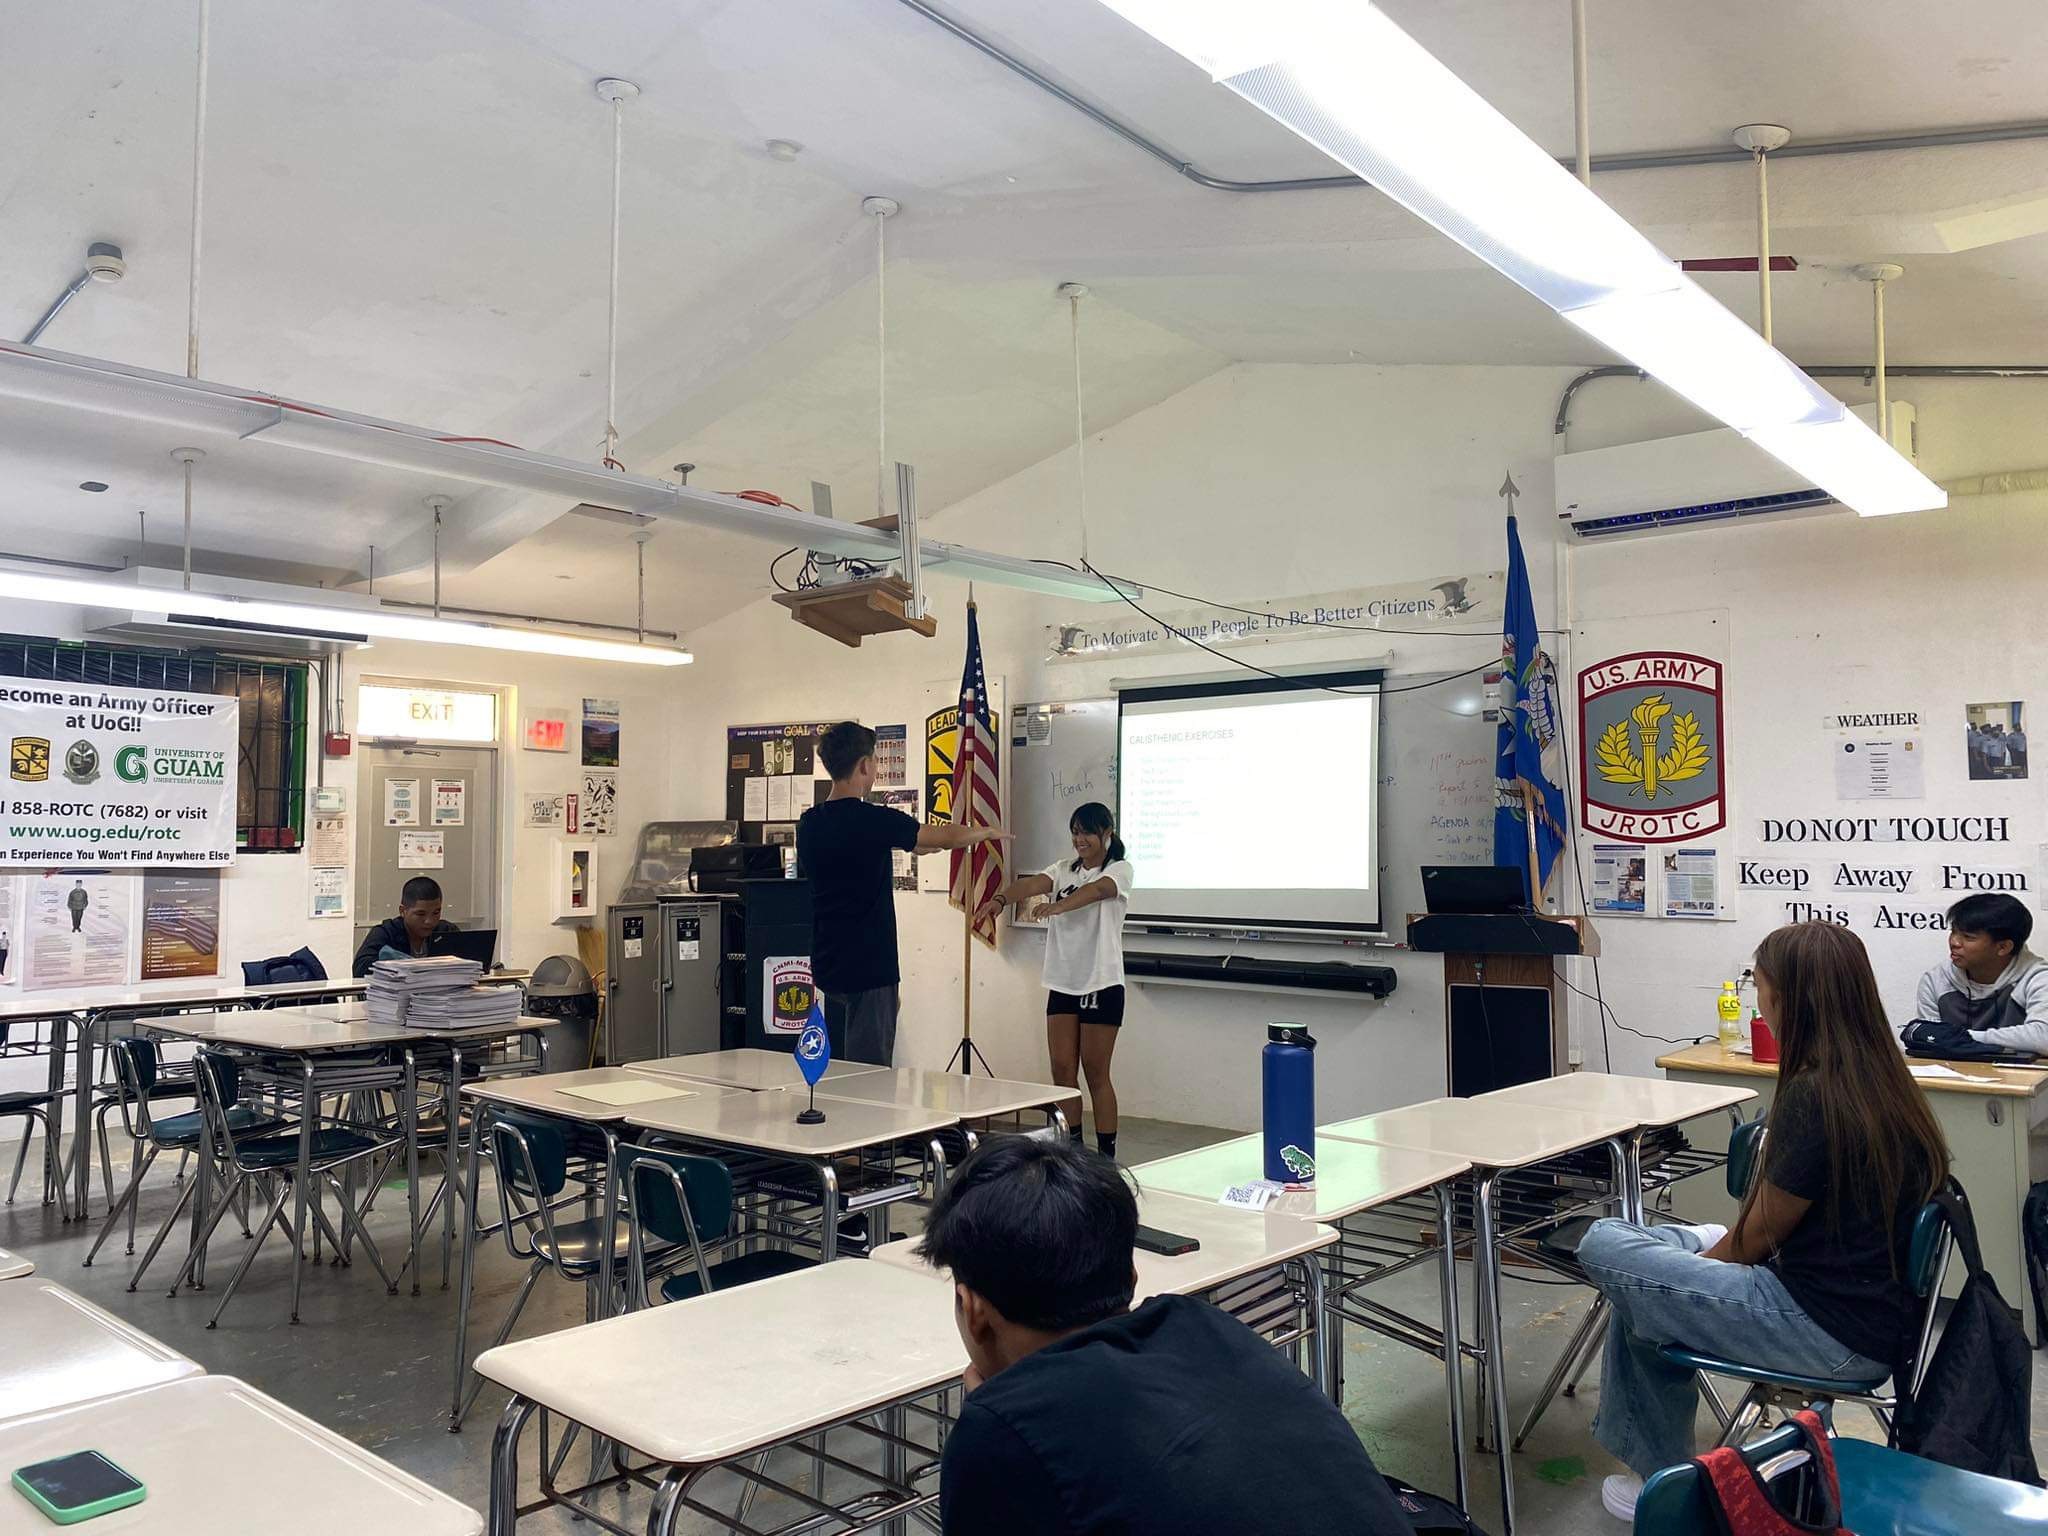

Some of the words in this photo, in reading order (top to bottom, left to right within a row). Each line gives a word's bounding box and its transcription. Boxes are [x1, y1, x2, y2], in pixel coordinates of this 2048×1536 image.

[1082, 634, 1098, 648] To
[1102, 629, 1159, 646] Motivate
[1163, 624, 1208, 640] Young
[1212, 616, 1259, 638] People
[1264, 613, 1284, 628] To
[1288, 611, 1308, 626] Be
[1314, 607, 1363, 623] Better
[1368, 598, 1436, 617] Citizens
[1588, 665, 1629, 691] U.S.
[1634, 660, 1709, 683] ARMY
[0, 688, 63, 705] ecome
[69, 694, 92, 708] an
[97, 693, 147, 714] Army
[152, 697, 215, 716] Officer
[411, 702, 454, 721] EXIT
[66, 714, 85, 730] at
[91, 714, 141, 732] UoG!!
[1837, 713, 1918, 727] WEATHER
[534, 720, 567, 747] EXIT
[784, 725, 810, 737] GOAL
[154, 748, 211, 759] UNIVERSITY
[213, 751, 225, 759] OF
[154, 758, 224, 777] GUAM
[12, 802, 94, 817] 858-ROTC
[100, 804, 149, 820] (7682)
[155, 808, 172, 819] or
[176, 807, 208, 820] visit
[1600, 811, 1701, 836] JROTC
[1890, 817, 2009, 842] TOUCH
[9, 825, 181, 842] www.uog.edu/rotc
[11, 848, 73, 861] Experience
[76, 850, 95, 860] You
[99, 850, 128, 860] Won't
[131, 850, 153, 860] Find
[156, 850, 206, 862] Anywhere
[209, 851, 230, 861] Else
[1739, 862, 1809, 890] Keep
[1834, 863, 1914, 893] Away
[1943, 866, 2028, 891] From
[1785, 902, 1849, 928] This
[1873, 905, 1949, 930] Area
[781, 1020, 806, 1028] JROTC
